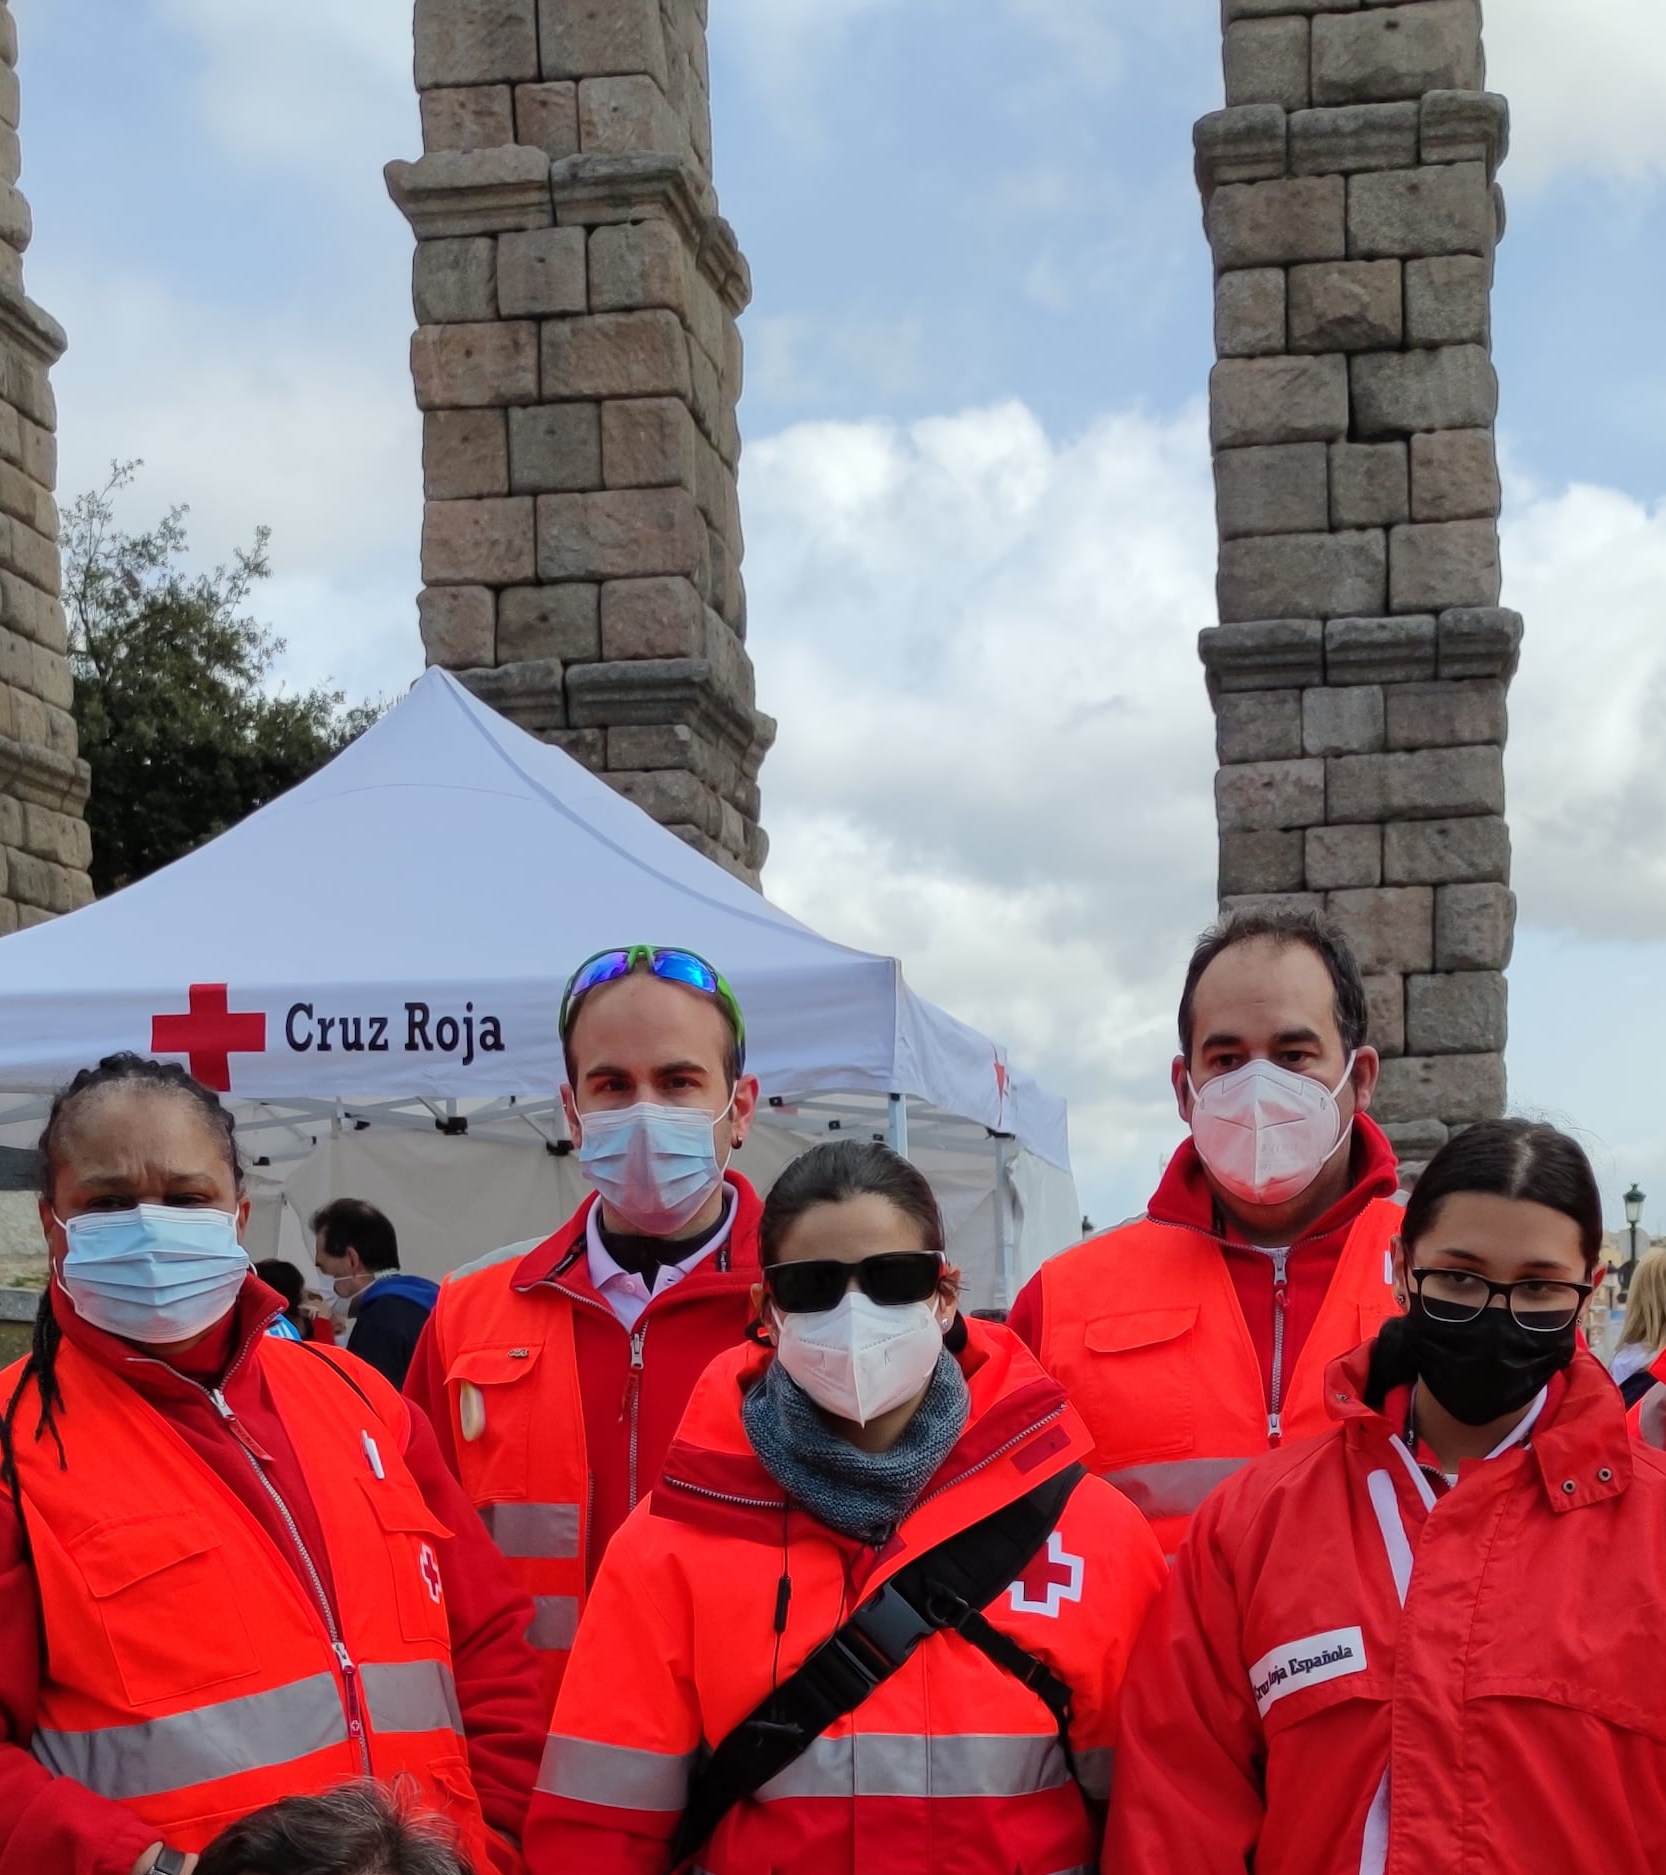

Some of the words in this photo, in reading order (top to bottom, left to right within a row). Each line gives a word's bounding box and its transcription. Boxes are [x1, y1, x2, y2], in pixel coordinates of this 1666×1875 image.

[285, 1002, 389, 1052] Cruz
[404, 1001, 506, 1066] Roja
[1288, 1645, 1353, 1676] Española
